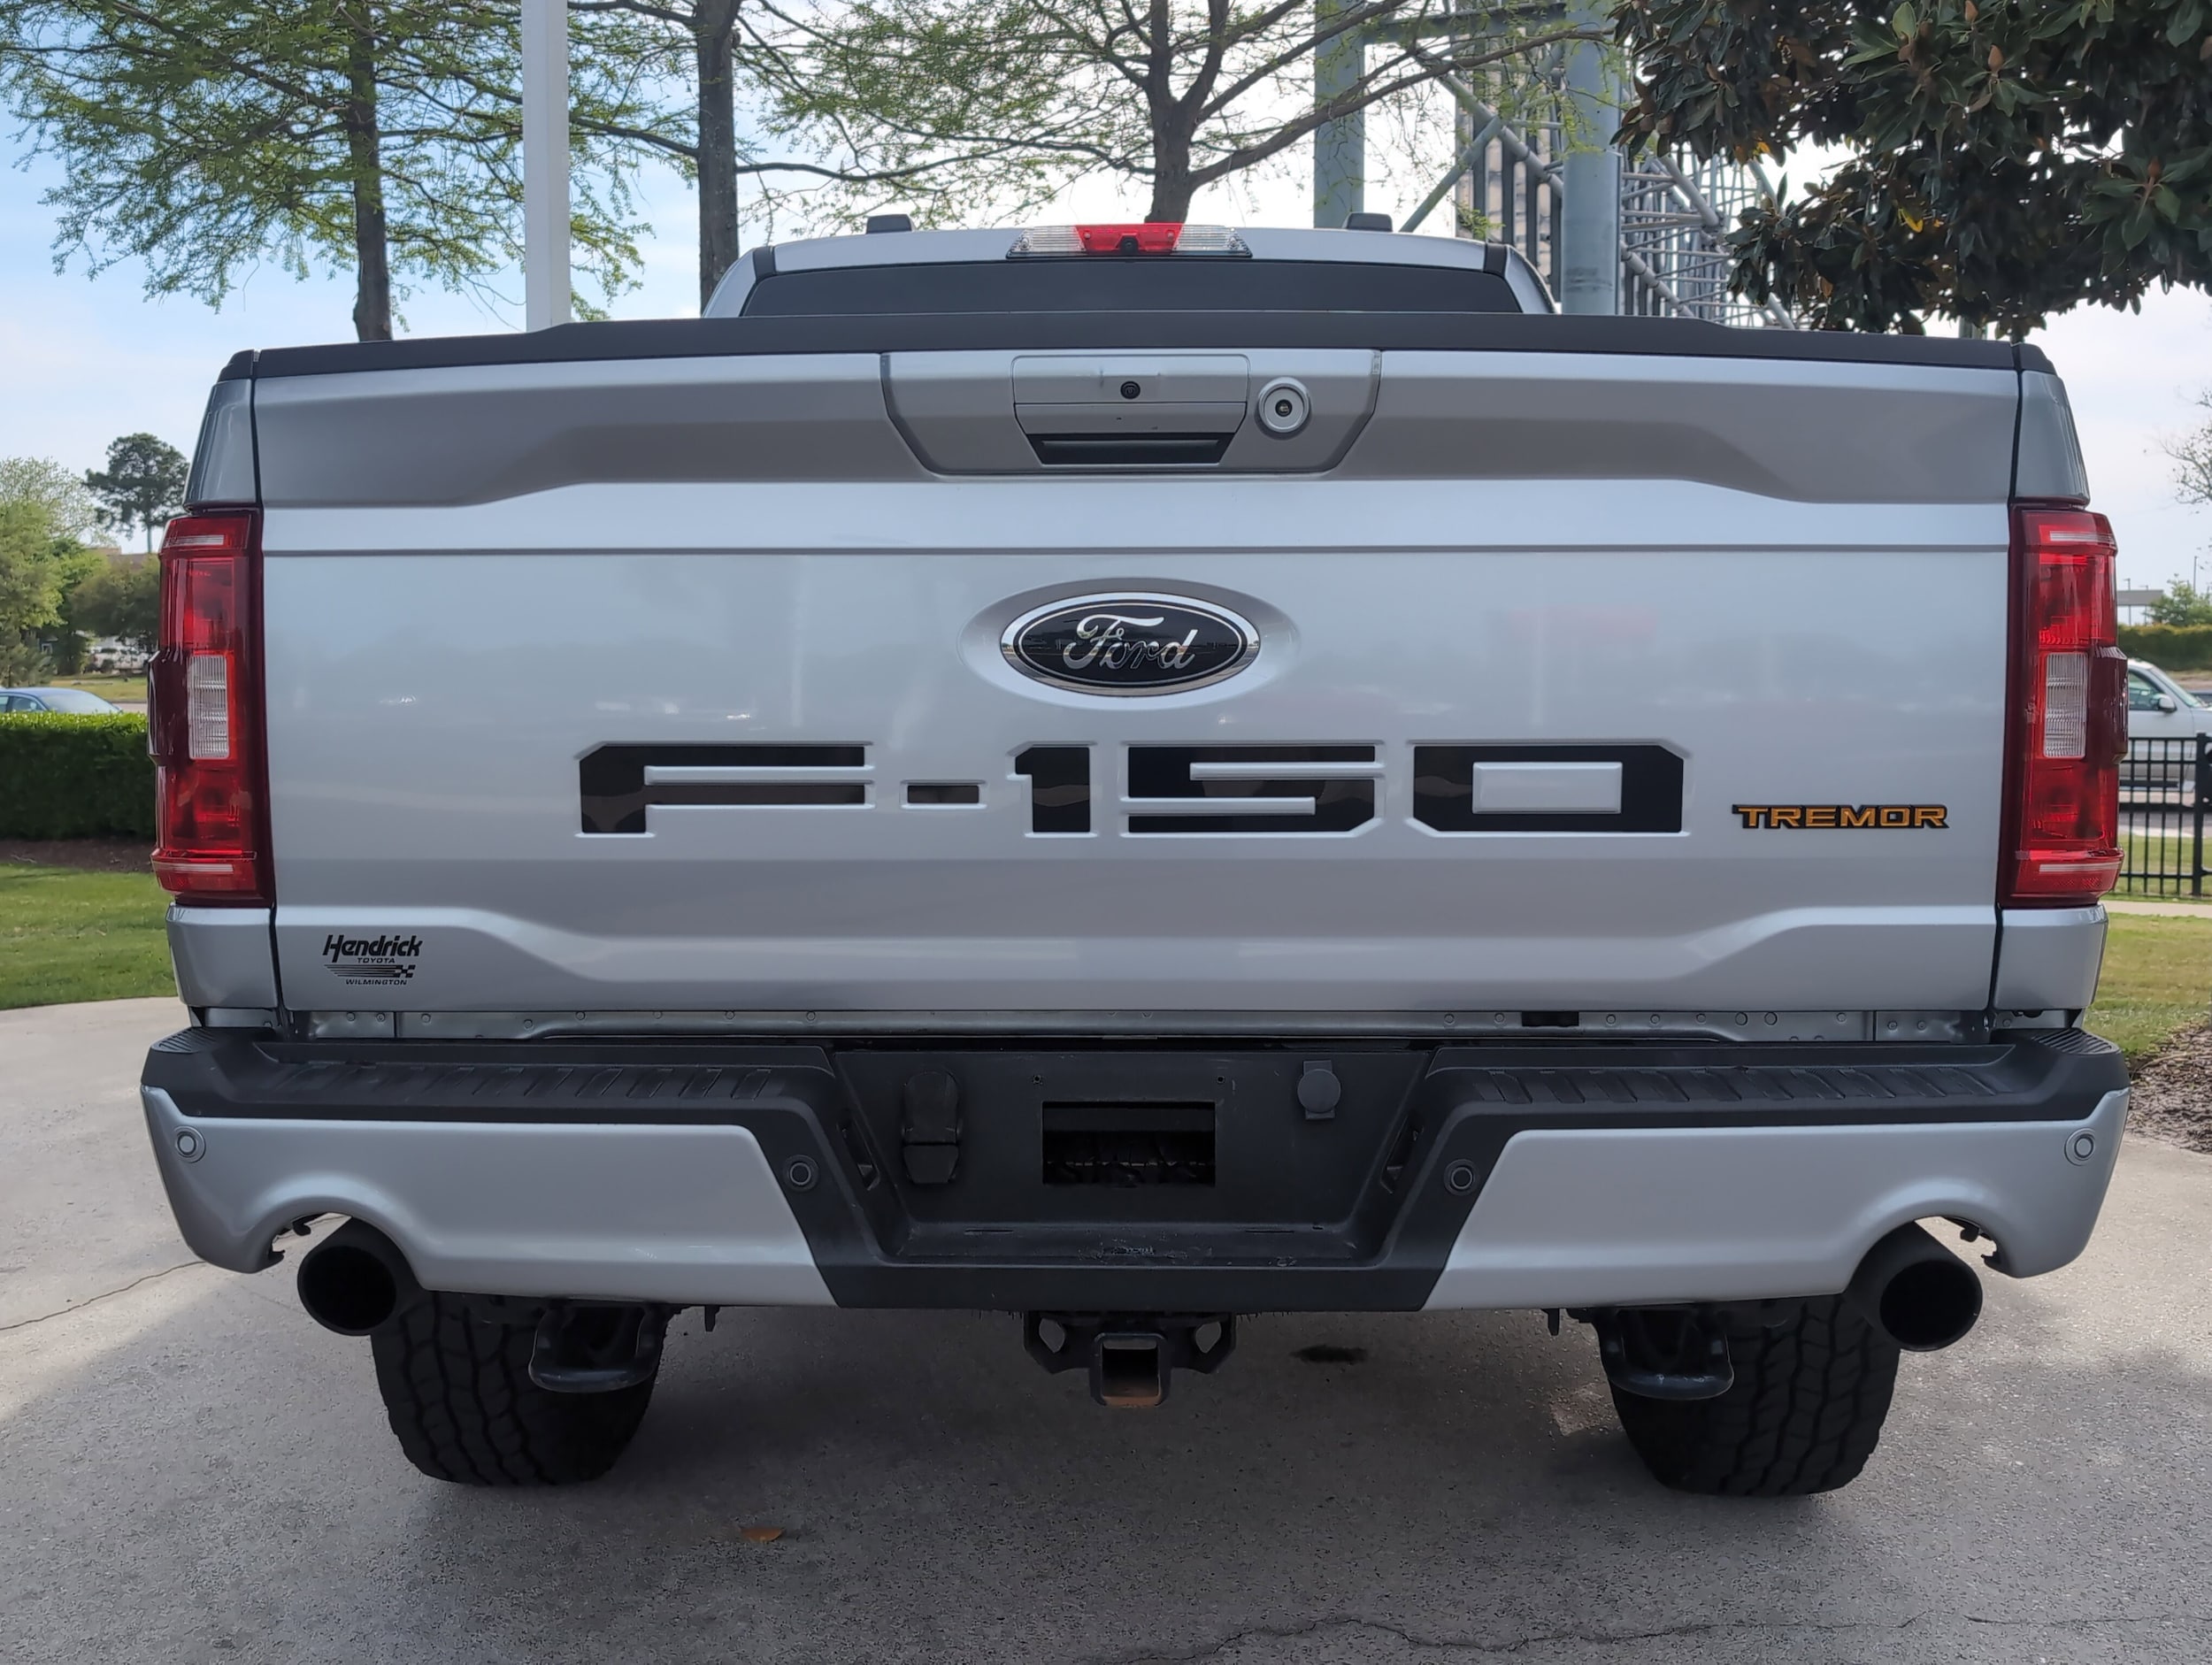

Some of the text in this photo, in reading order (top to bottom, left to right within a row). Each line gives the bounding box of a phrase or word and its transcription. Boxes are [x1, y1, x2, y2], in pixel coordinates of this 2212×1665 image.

[1064, 614, 1198, 670] Ford
[580, 744, 1685, 833] F-150
[1732, 804, 1949, 829] TREMOR
[322, 934, 423, 963] Hendrick
